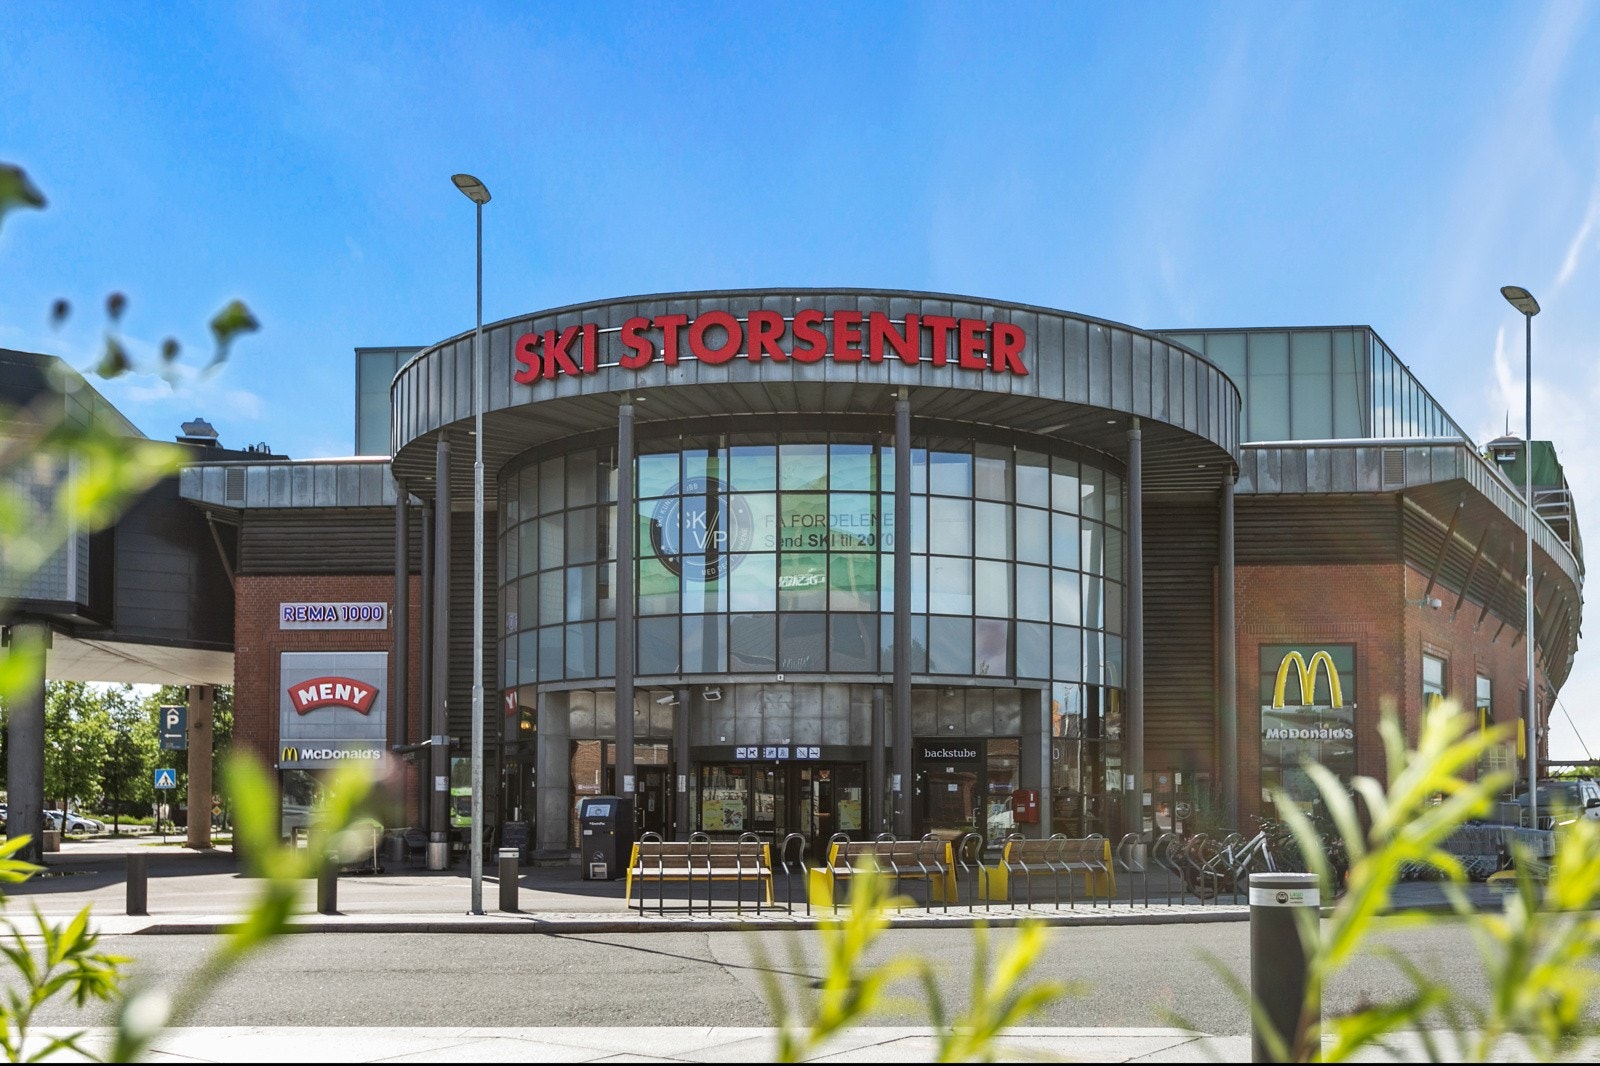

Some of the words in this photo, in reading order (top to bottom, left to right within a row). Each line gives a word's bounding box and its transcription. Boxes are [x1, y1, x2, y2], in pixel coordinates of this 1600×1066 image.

[514, 323, 599, 384] SKI
[618, 309, 1029, 376] STORSENTER
[791, 513, 894, 528] FORDELENE
[808, 534, 835, 548] SKI
[840, 533, 852, 547] til
[282, 605, 336, 621] REMA
[341, 605, 382, 622] 1000
[298, 683, 368, 706] MENY
[1265, 728, 1354, 740] McDonald's
[300, 748, 381, 761] McDonald's
[924, 748, 977, 759] backstube
